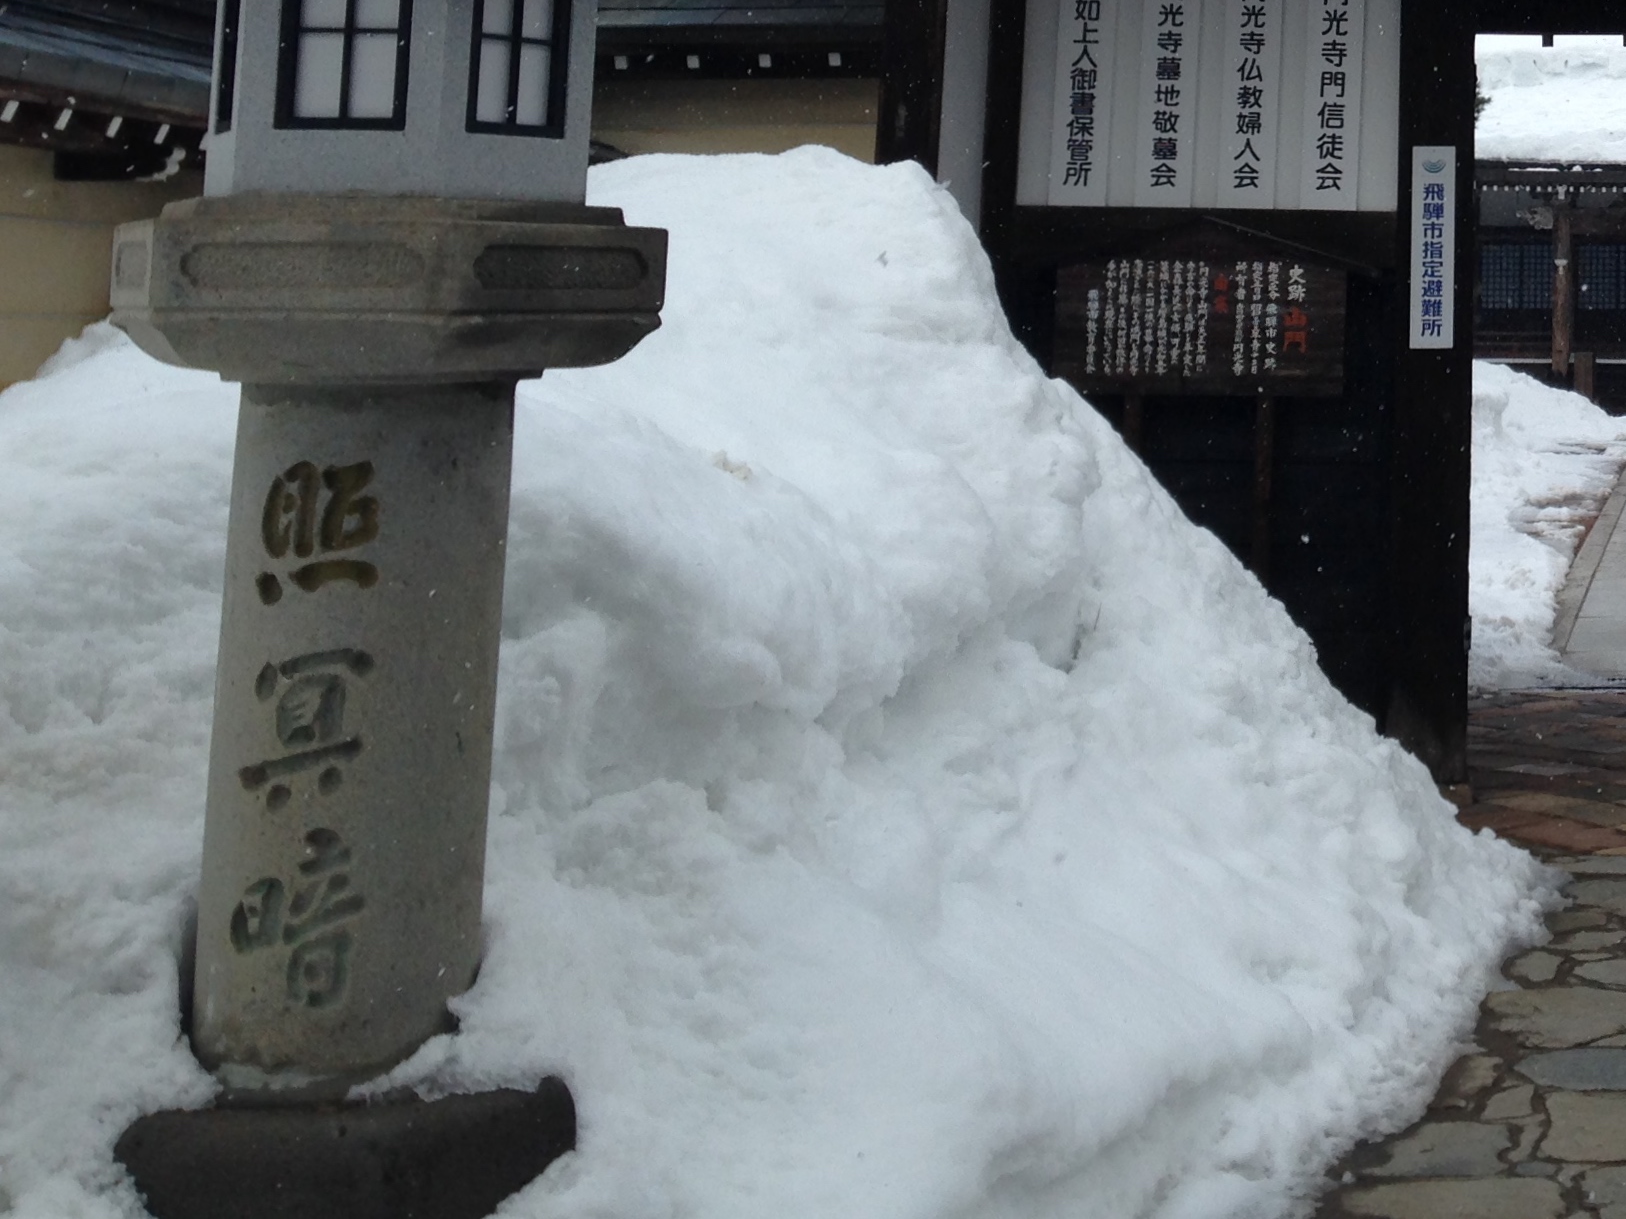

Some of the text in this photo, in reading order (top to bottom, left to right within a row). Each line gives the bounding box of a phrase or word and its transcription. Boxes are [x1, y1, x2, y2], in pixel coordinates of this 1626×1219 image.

[1282, 264, 1308, 354] 史跡 山門
[1420, 182, 1446, 338] 飛騨市指定避難所
